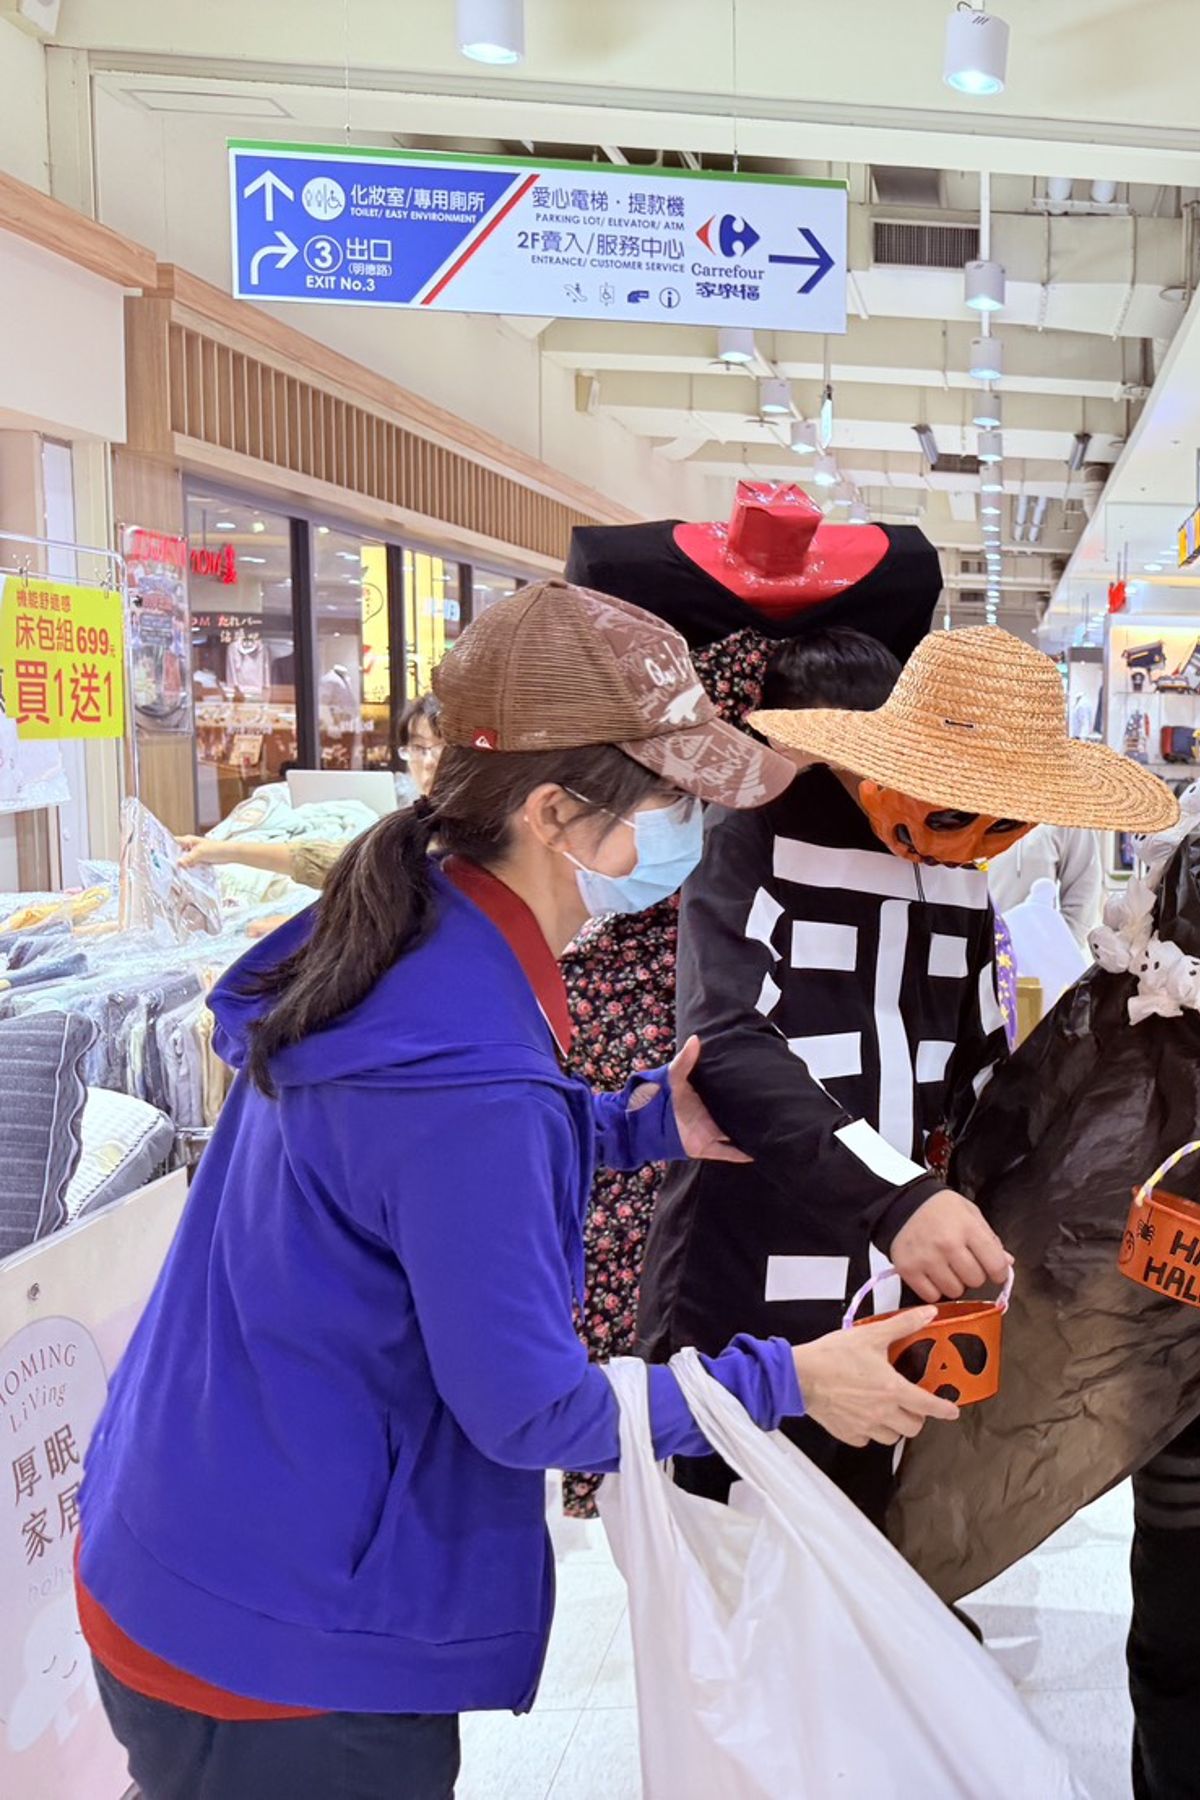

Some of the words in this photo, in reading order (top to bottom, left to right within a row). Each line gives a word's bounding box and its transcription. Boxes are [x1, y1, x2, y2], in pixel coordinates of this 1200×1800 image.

[350, 207, 383, 219] TOILET/
[385, 210, 409, 219] EASY
[410, 211, 477, 223] ENVIRONMENT
[535, 212, 580, 224] PARKING
[582, 216, 605, 227] LOT/
[607, 217, 661, 230] ELEVATOR/
[663, 221, 685, 231] ATM
[346, 237, 392, 261] 出口
[531, 254, 587, 267] ENTRANCE/
[590, 258, 643, 270] CUSTOMER
[645, 262, 685, 273] SERVICE
[691, 262, 765, 280] Carrefour
[306, 275, 336, 290] EXIT
[340, 277, 376, 292] No.3
[15, 659, 113, 724] 買1送1
[12, 1423, 81, 1507] 厚眠
